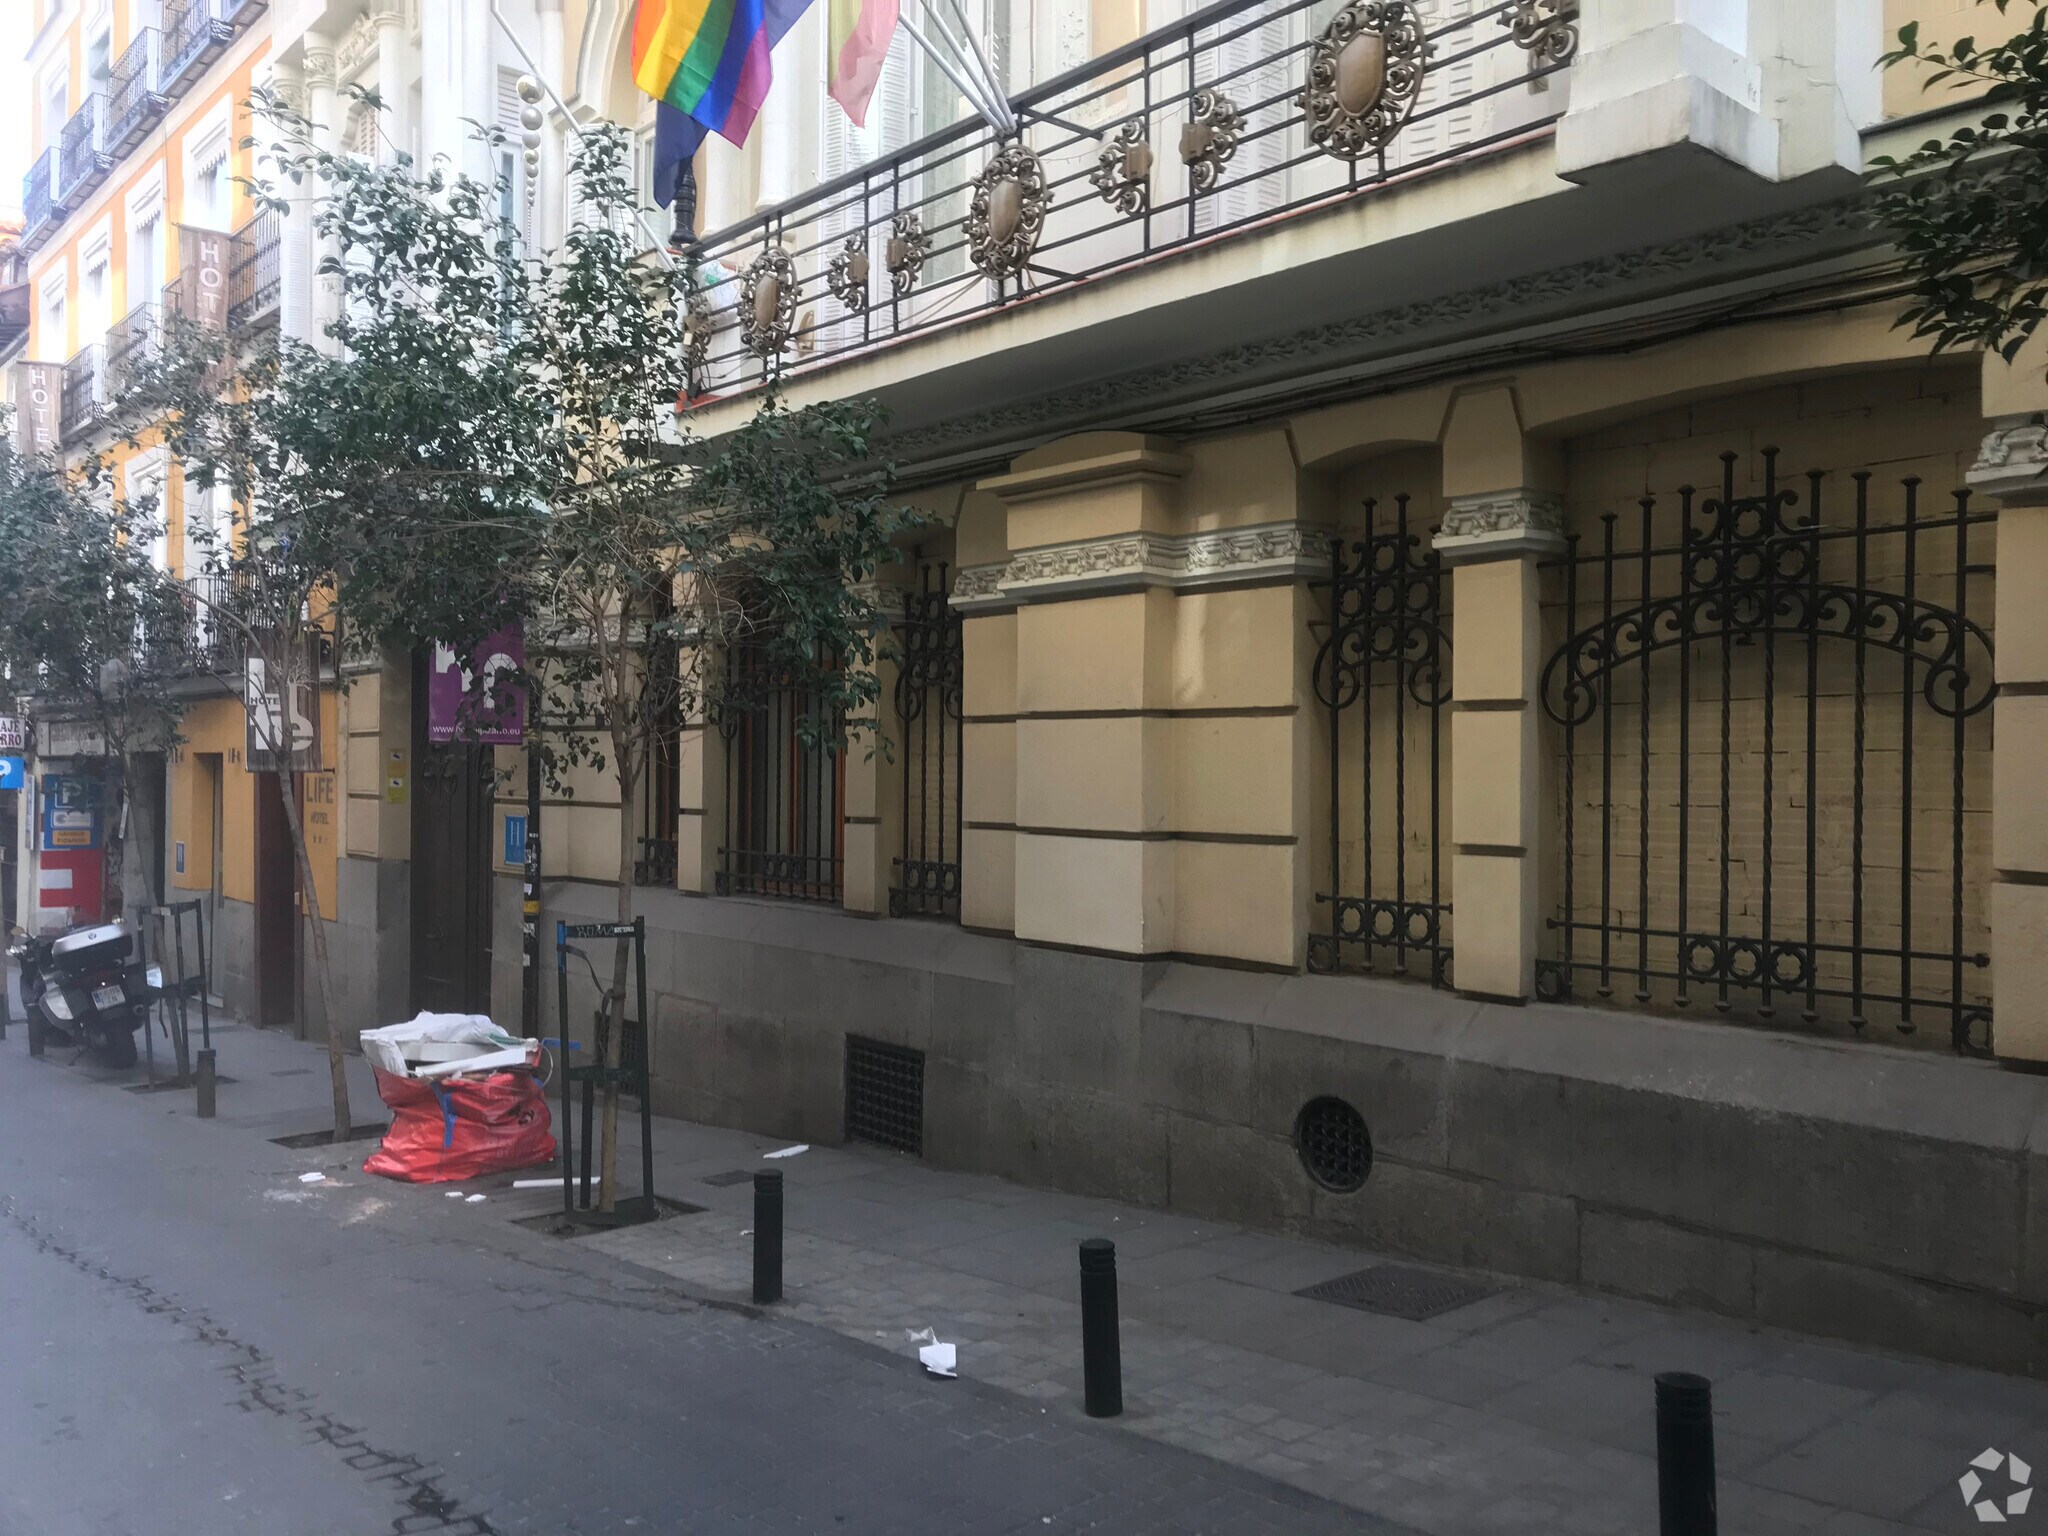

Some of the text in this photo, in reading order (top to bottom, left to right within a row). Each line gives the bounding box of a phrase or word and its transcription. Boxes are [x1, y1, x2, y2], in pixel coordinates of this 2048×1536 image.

[200, 241, 222, 364] HOTE
[31, 369, 50, 455] HOTE
[250, 697, 281, 706] HOTE
[306, 777, 334, 804] LIFE
[310, 812, 330, 825] HOTEL
